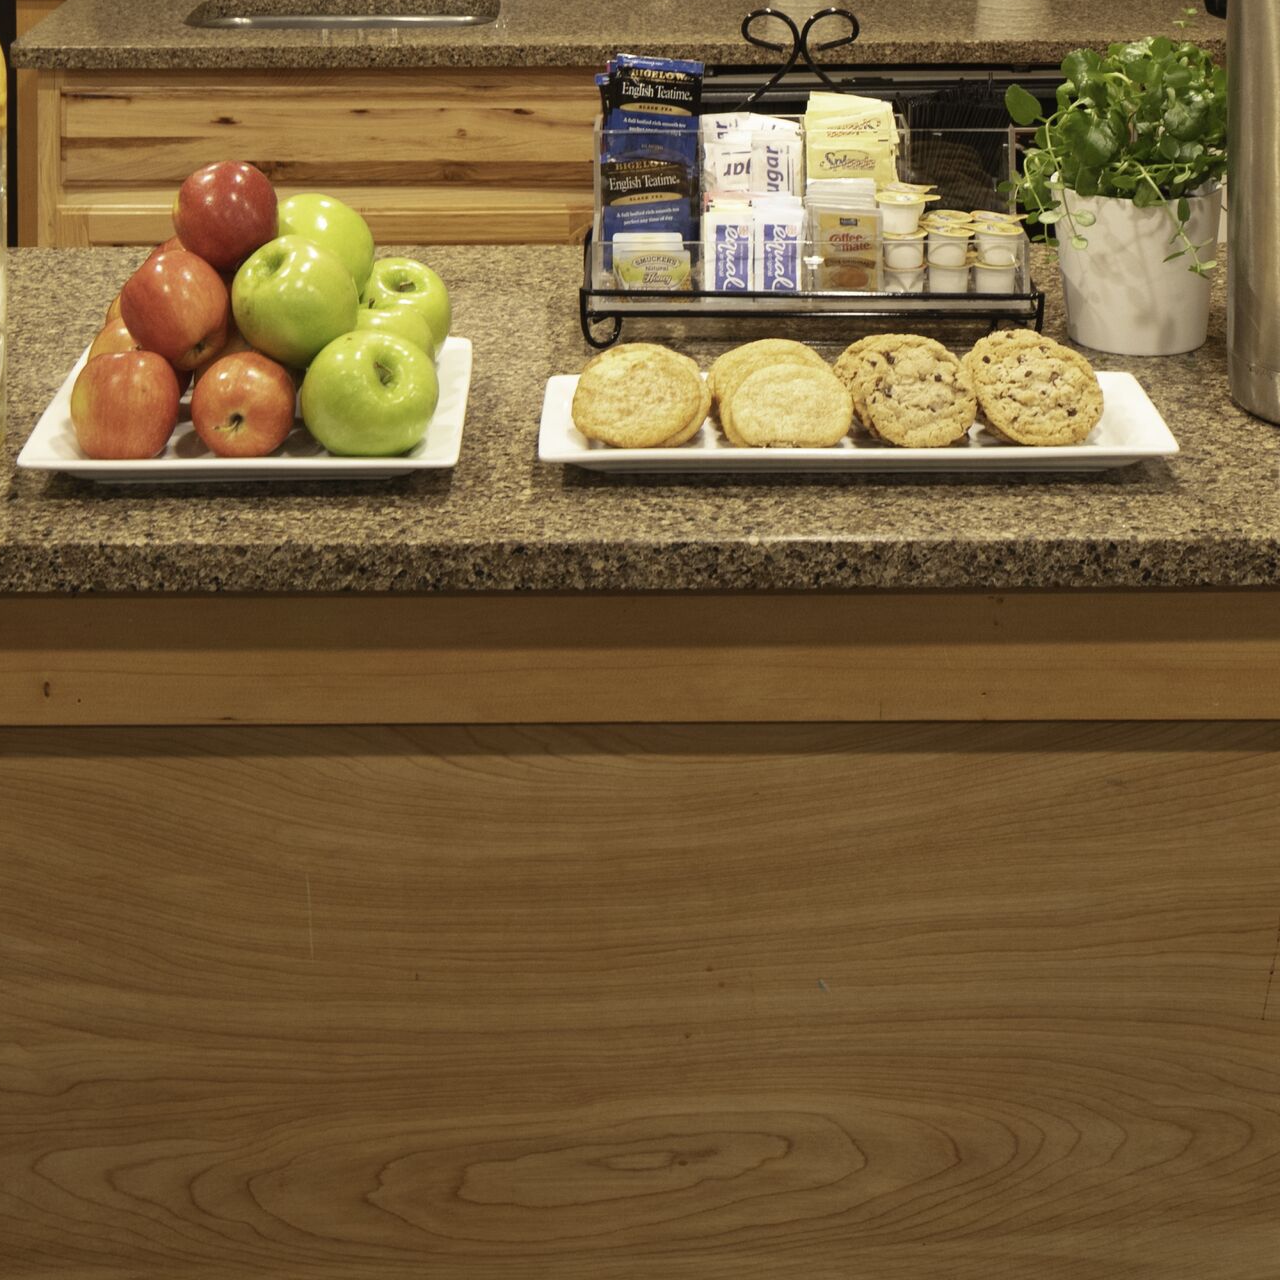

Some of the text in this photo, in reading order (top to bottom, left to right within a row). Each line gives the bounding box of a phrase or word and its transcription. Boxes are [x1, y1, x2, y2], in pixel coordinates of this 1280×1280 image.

[622, 81, 654, 99] English
[609, 175, 642, 193] English
[718, 224, 745, 291] equal
[766, 223, 794, 291] equal
[642, 270, 672, 286] Honey
